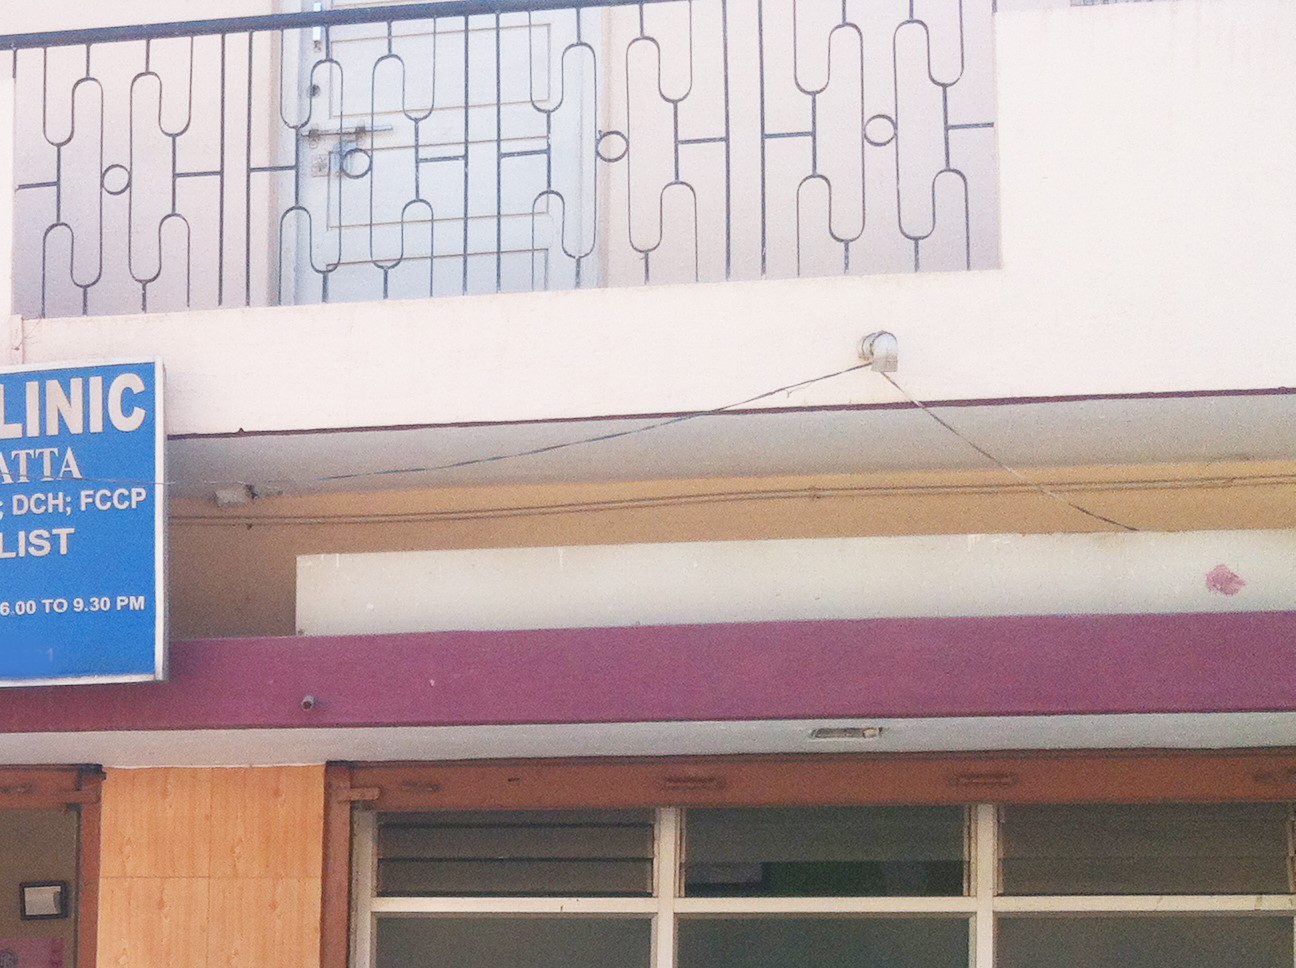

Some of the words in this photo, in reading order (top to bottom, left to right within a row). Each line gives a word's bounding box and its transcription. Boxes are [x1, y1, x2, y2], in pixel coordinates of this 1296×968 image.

[12, 491, 72, 516] DCH;
[80, 487, 147, 511] FCCP
[0, 599, 37, 616] 6.00
[41, 598, 69, 613] TO
[72, 597, 111, 612] 9.30
[116, 595, 145, 611] PM
